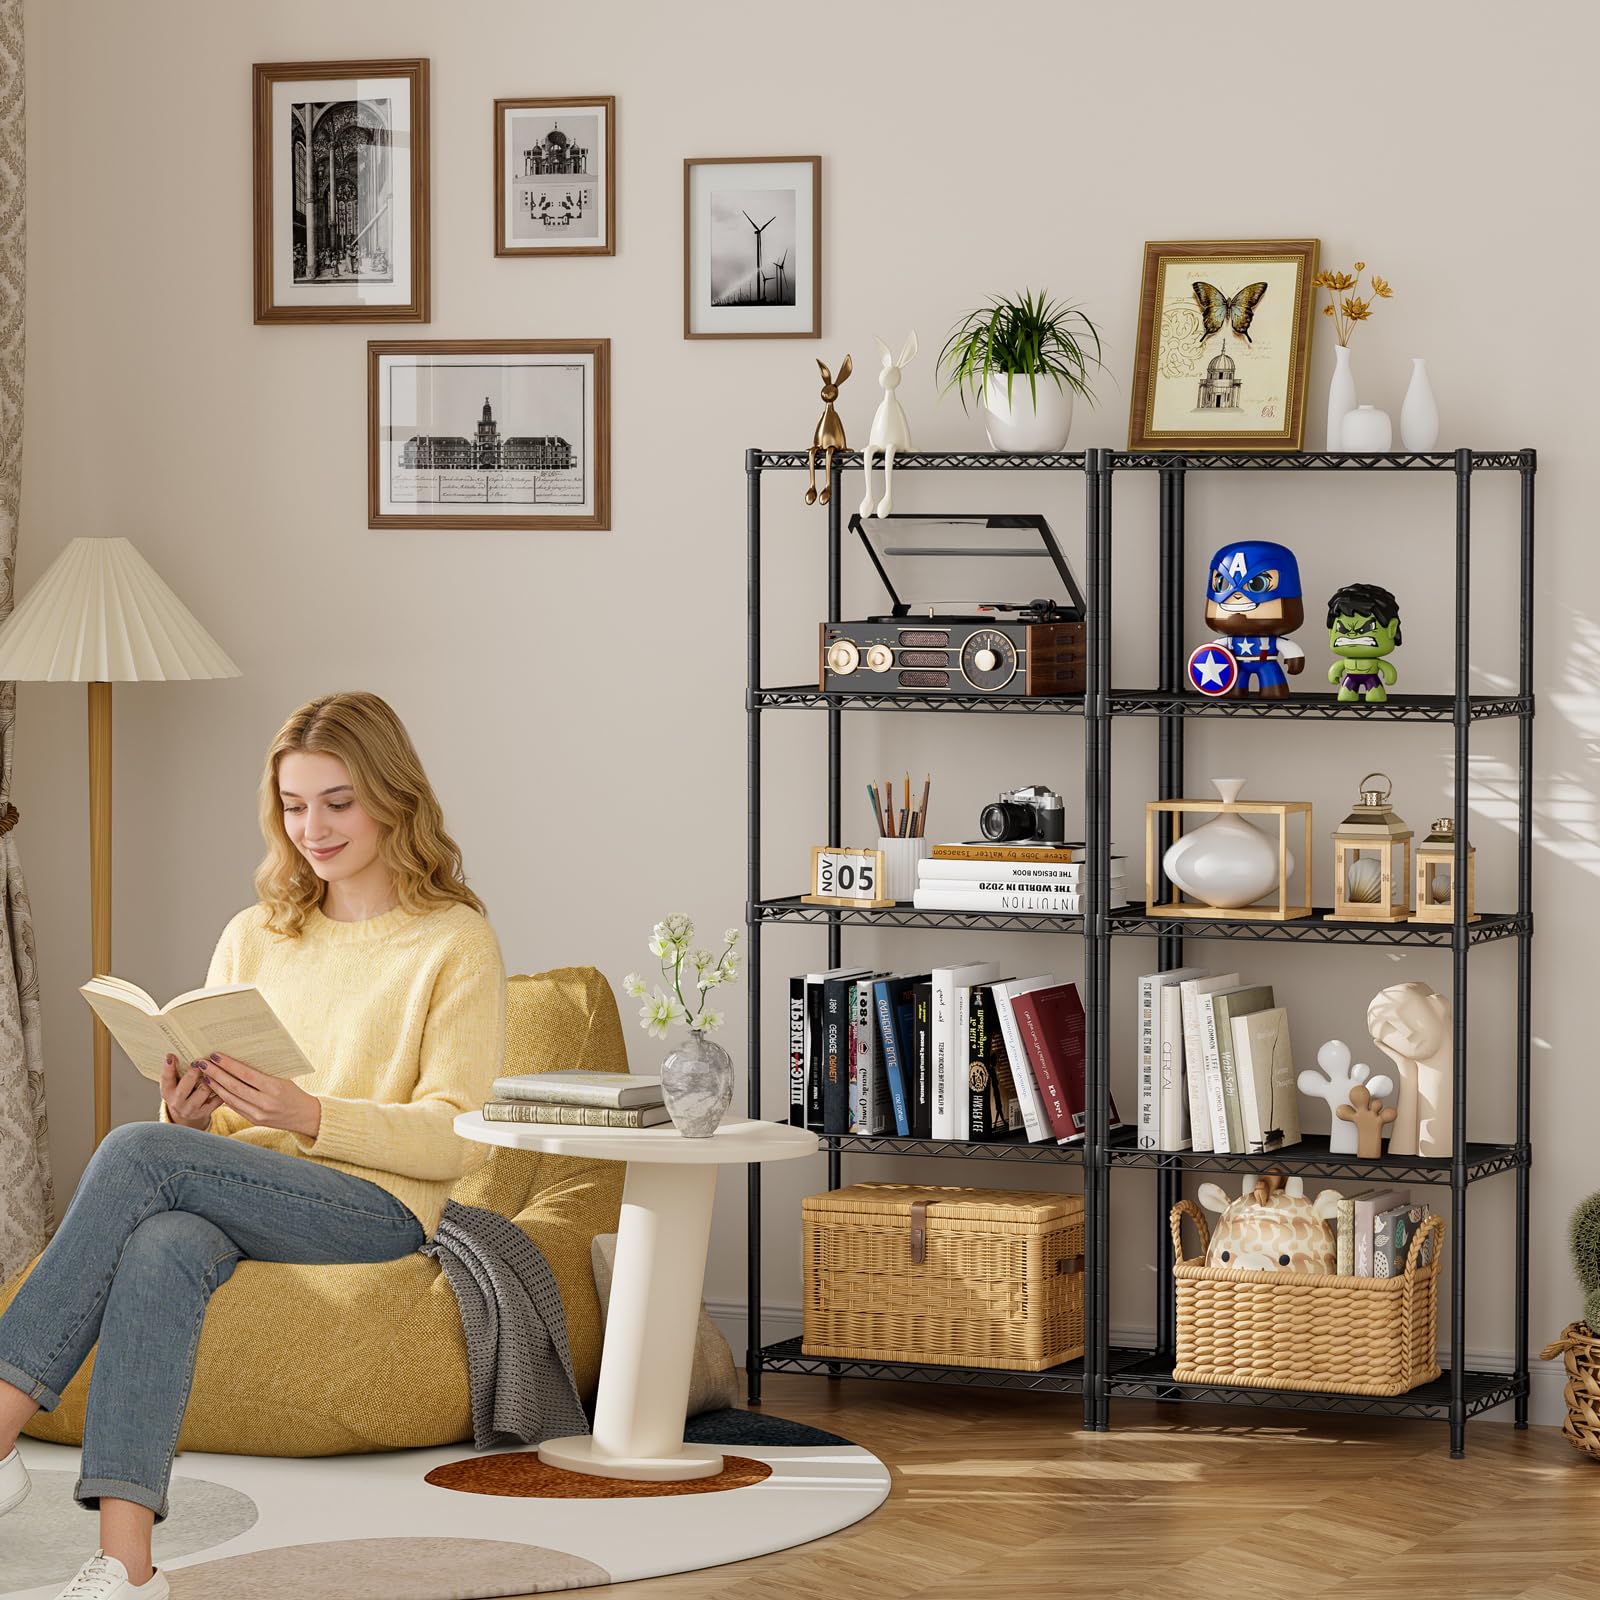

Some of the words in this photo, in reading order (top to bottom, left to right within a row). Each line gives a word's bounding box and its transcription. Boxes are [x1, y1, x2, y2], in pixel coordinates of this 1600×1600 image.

[1229, 552, 1247, 578] A
[975, 850, 1003, 858] Walter
[1007, 851, 1017, 859] by
[822, 859, 833, 891] NOV
[838, 865, 873, 890] 05
[979, 882, 1004, 891] 2020
[1018, 884, 1051, 892] WORLD
[1053, 885, 1071, 893] THE
[1001, 896, 1074, 910] INTUITION
[1143, 999, 1152, 1007] HOW
[1206, 1015, 1216, 1050] UNCOMMON
[1143, 1046, 1152, 1054] HOW
[1162, 1042, 1172, 1092] CEREAL
[1212, 1074, 1220, 1082] OF
[1222, 1051, 1235, 1097] Wabi-Sabi
[1143, 1075, 1152, 1084] WANT
[1215, 1086, 1223, 1111] COMMON
[1143, 1113, 1152, 1124] Arden
